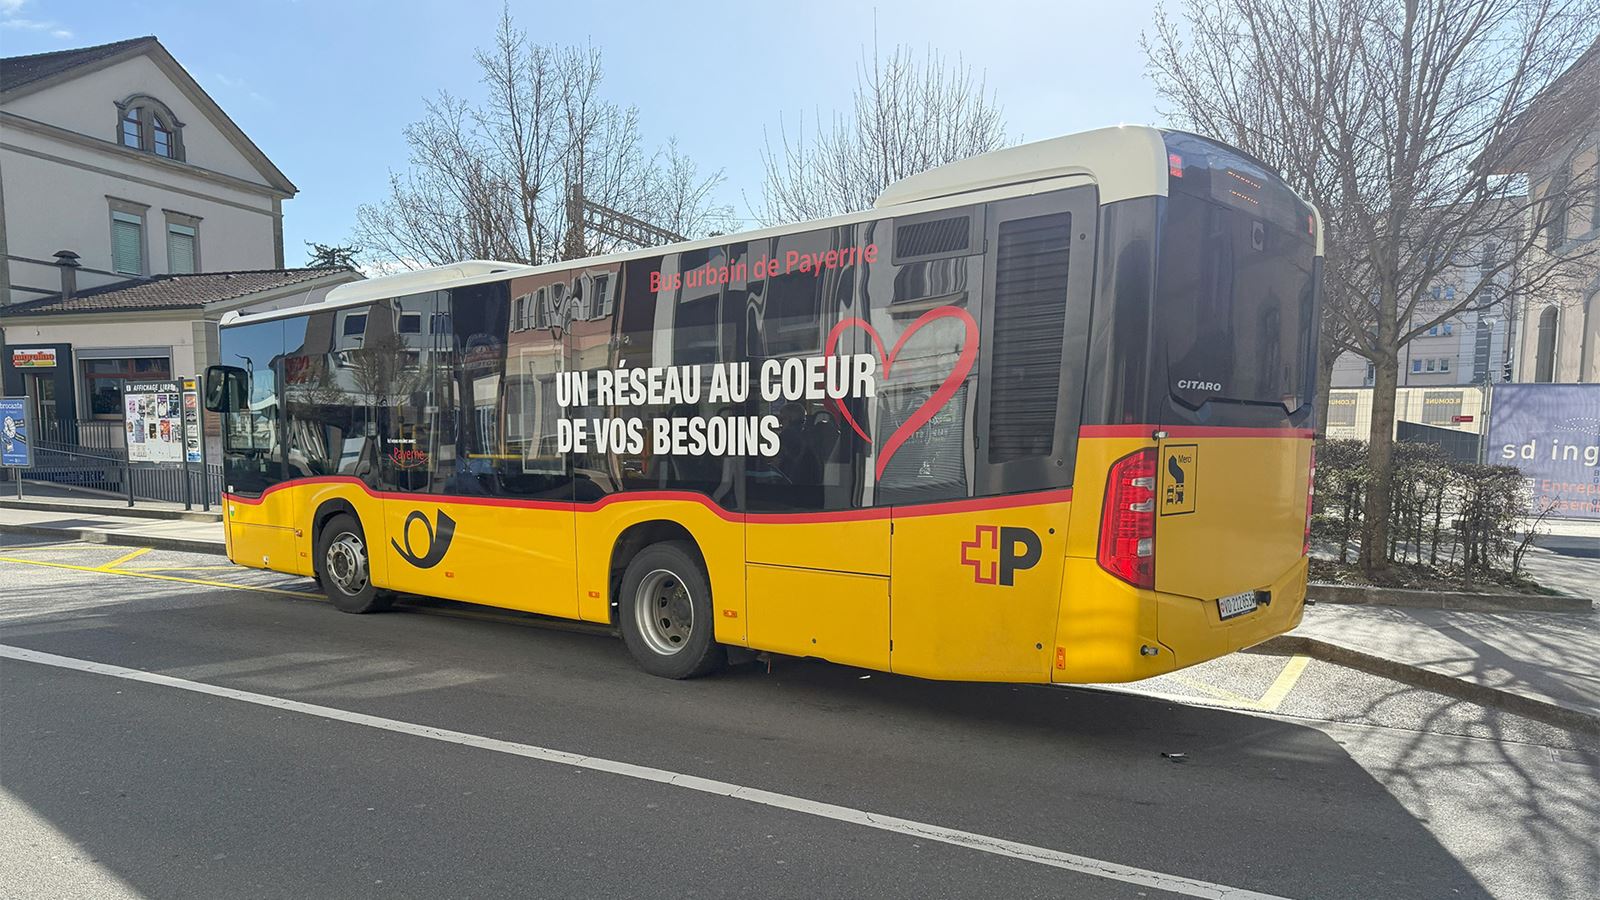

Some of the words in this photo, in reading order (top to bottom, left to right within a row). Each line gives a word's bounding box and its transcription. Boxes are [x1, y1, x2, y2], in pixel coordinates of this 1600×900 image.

[650, 271, 681, 293] Bus
[685, 259, 747, 289] urbain
[754, 252, 779, 278] de
[785, 243, 878, 279] Payerne
[556, 371, 588, 407] UN
[598, 359, 701, 406] RÉSEAU
[709, 361, 749, 403] AU
[760, 353, 876, 401] COEUR
[1177, 379, 1221, 392] CITARO
[394, 447, 425, 461] Payerne
[557, 418, 587, 454] DE
[593, 416, 643, 455] VOS
[654, 415, 781, 457] BESOINS
[1502, 439, 1536, 459] sd
[1000, 527, 1041, 586] P
